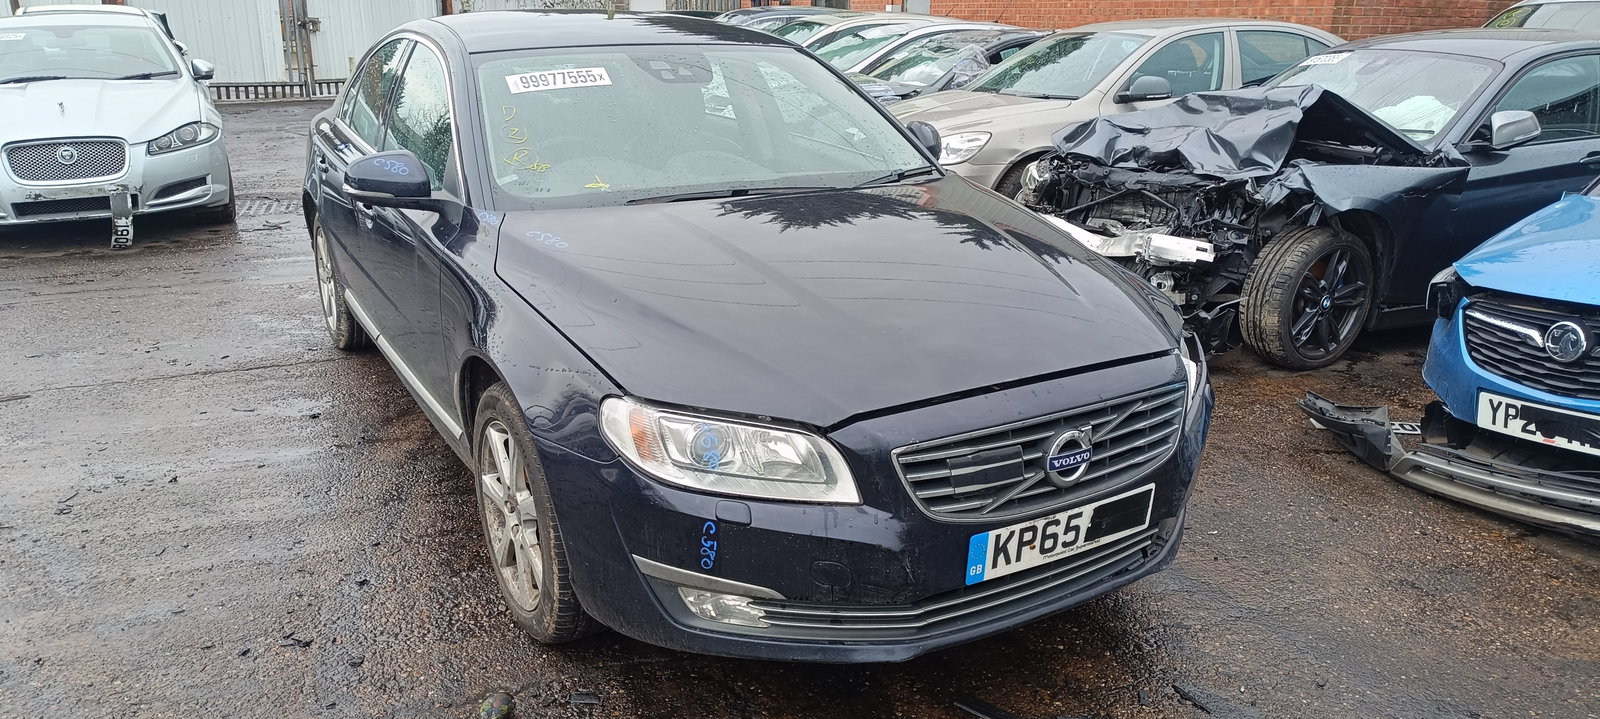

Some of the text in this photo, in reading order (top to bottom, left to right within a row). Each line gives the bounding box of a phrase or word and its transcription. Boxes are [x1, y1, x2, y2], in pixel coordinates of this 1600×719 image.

[373, 158, 409, 175] C580
[526, 231, 569, 248] C580
[1052, 452, 1090, 468] VOLVO
[701, 521, 717, 569] C580
[991, 511, 1084, 570] KP65
[969, 563, 983, 576] GB
